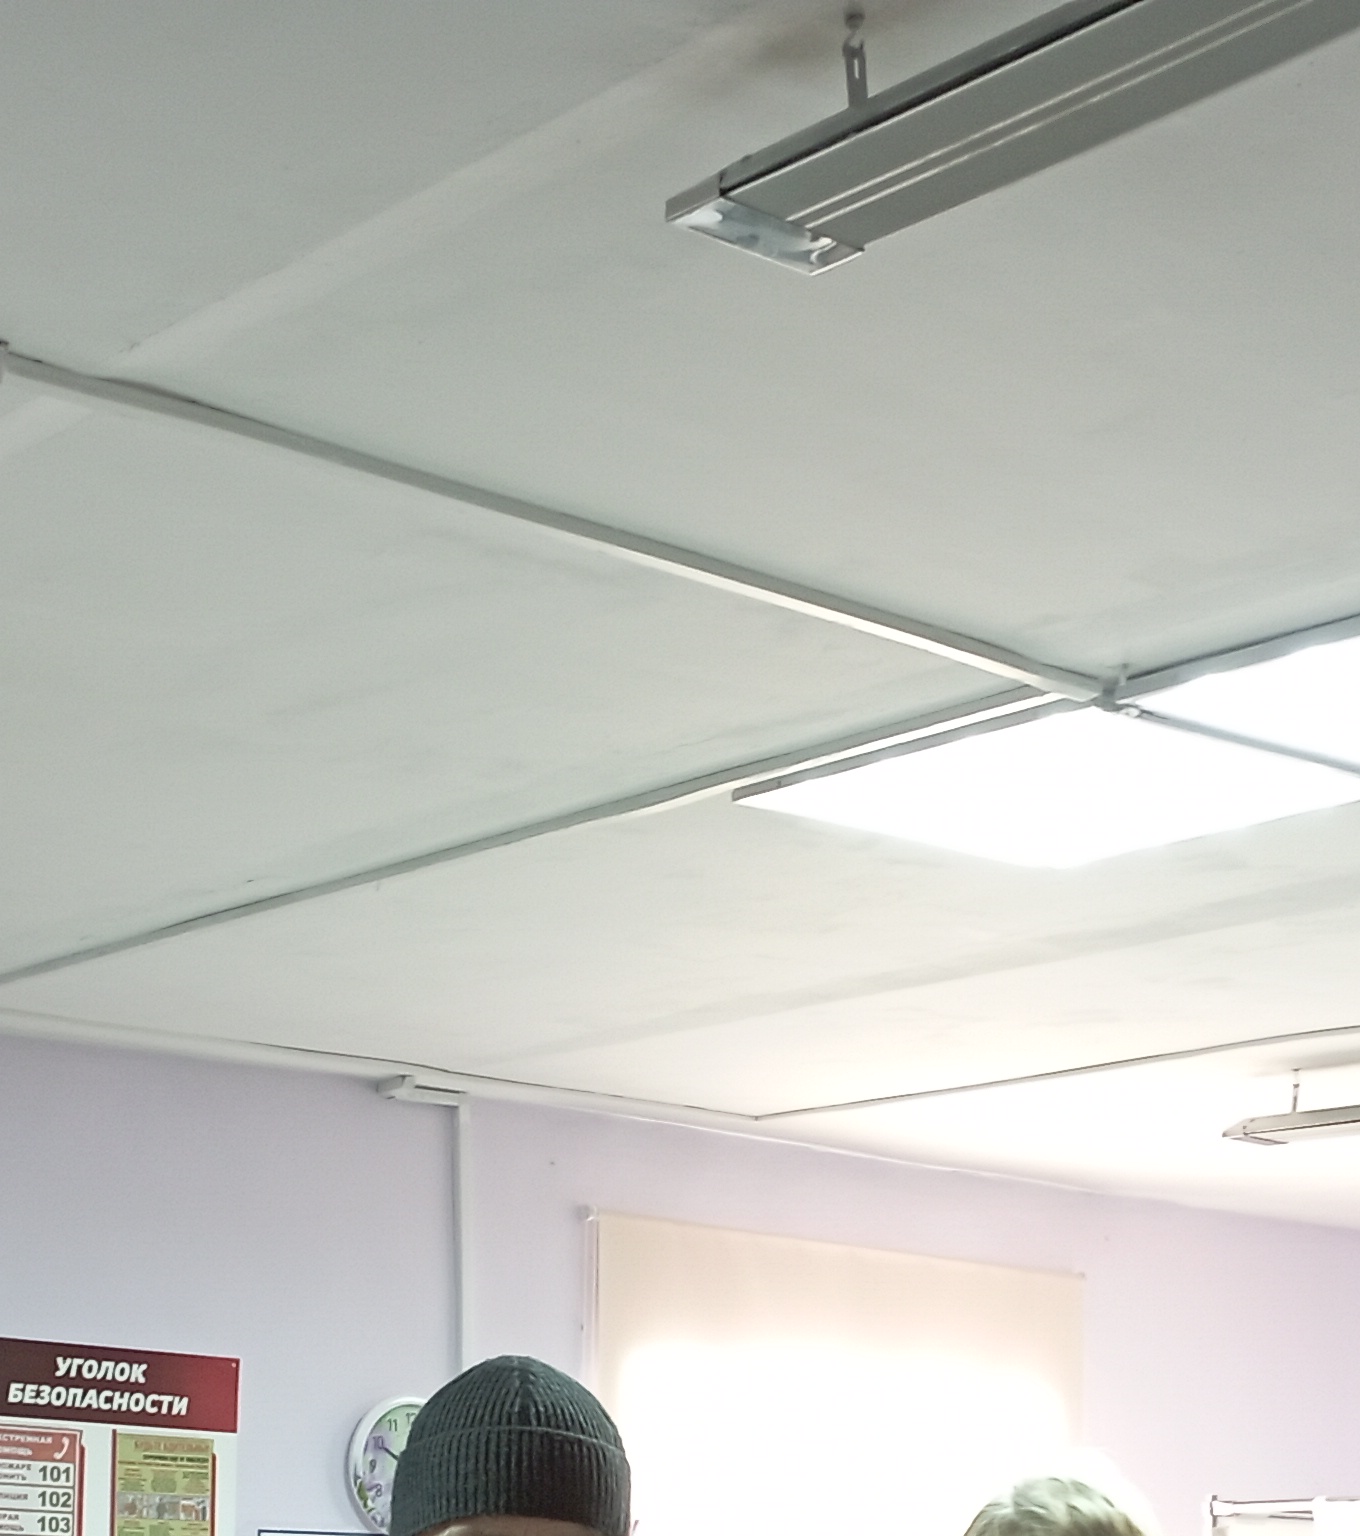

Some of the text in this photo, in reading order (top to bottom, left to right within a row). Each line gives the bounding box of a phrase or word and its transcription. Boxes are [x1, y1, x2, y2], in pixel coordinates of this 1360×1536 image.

[54, 1356, 148, 1384] УГОЛОК
[7, 1382, 189, 1417] БЕЗОПАСНОСТИ
[386, 1418, 398, 1432] 11
[38, 1465, 71, 1483] 101
[37, 1490, 72, 1508] 102
[36, 1515, 71, 1533] 103
